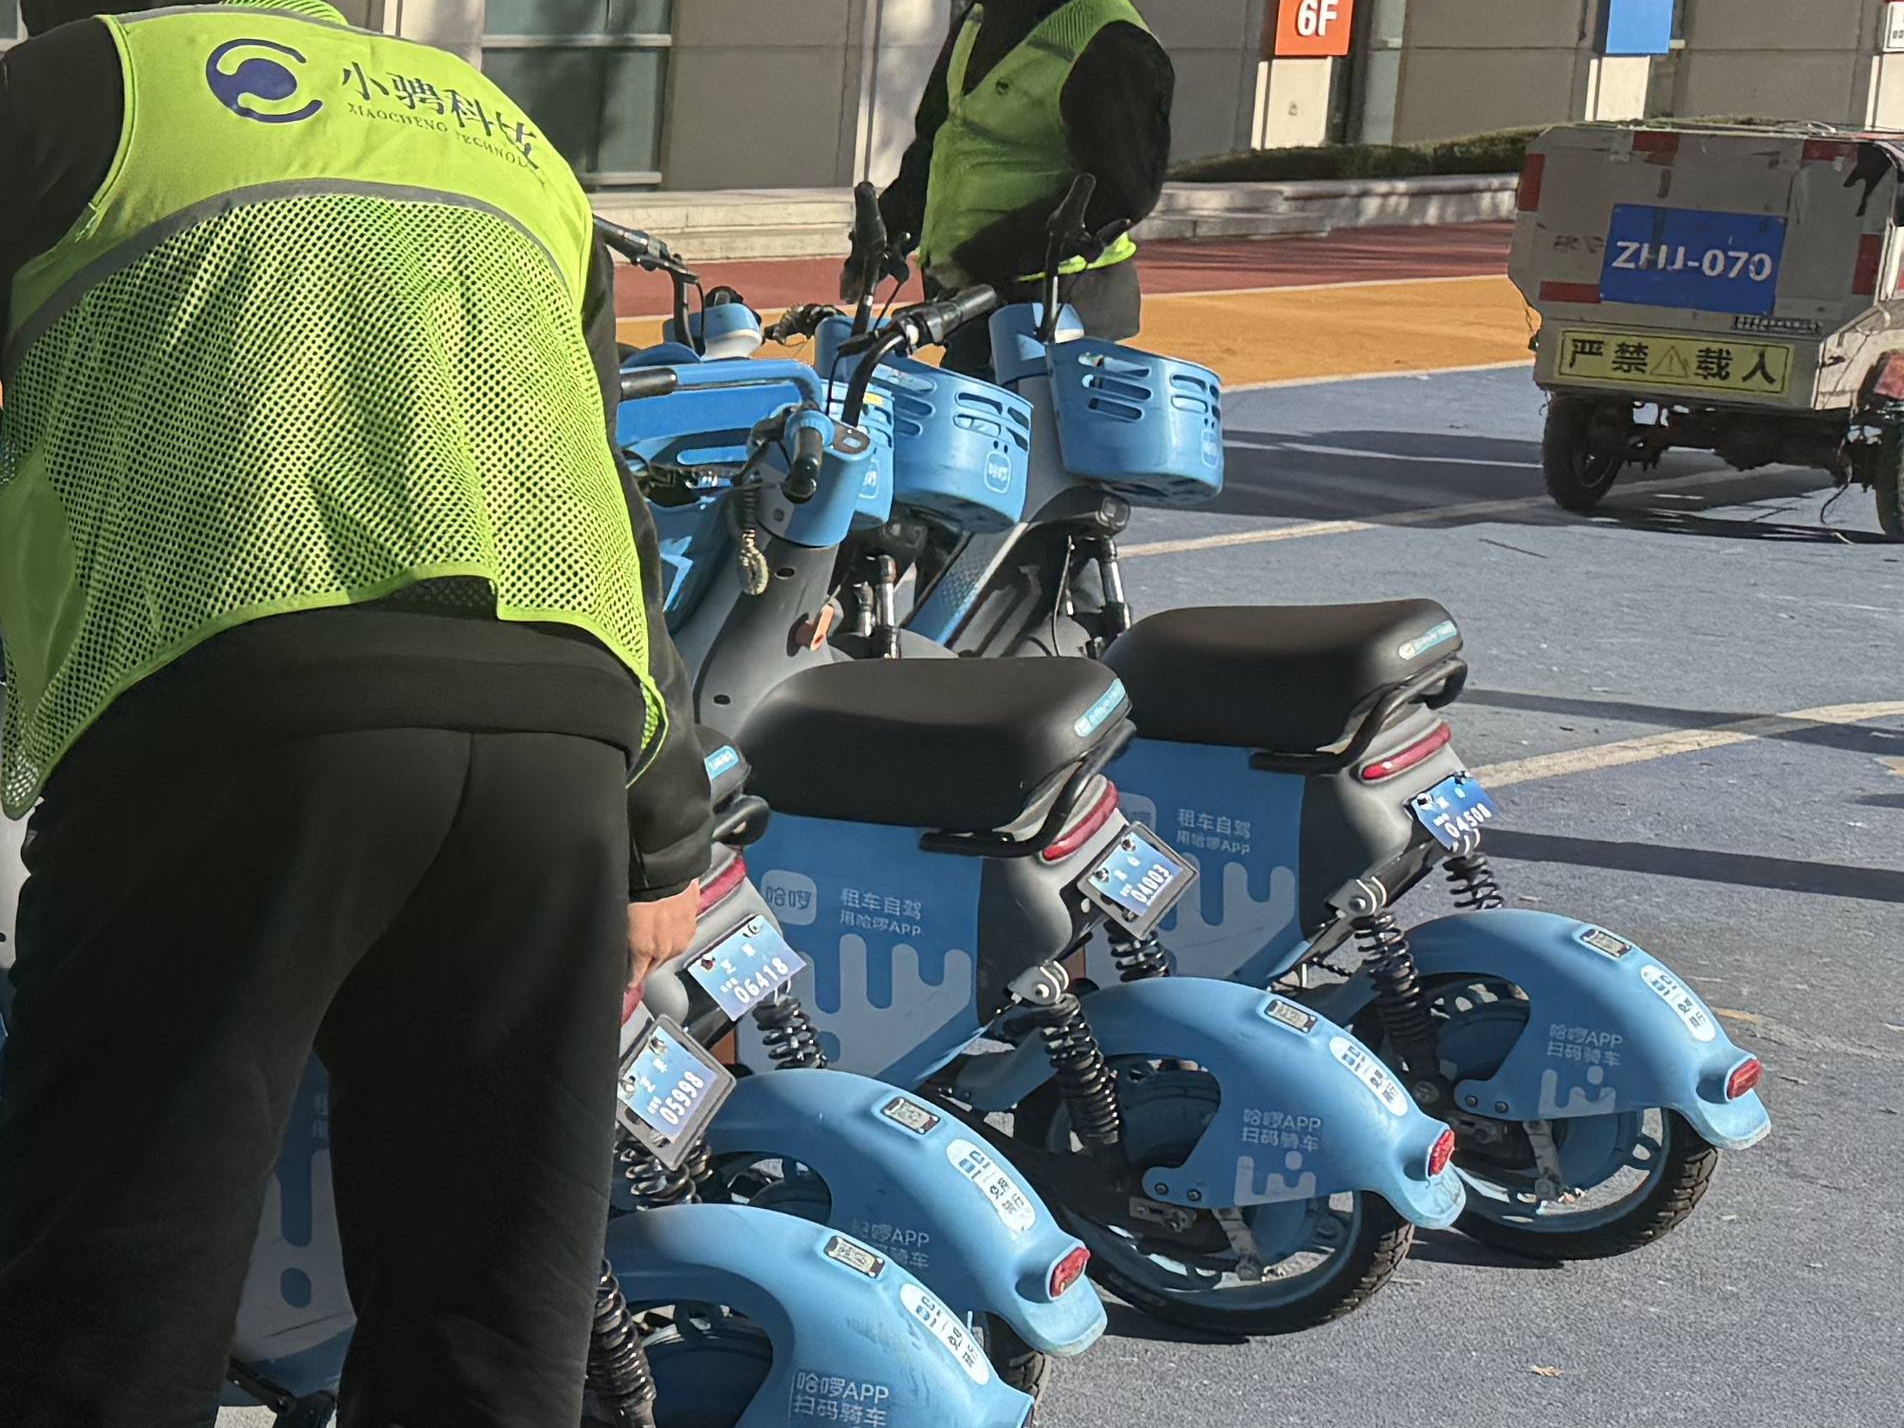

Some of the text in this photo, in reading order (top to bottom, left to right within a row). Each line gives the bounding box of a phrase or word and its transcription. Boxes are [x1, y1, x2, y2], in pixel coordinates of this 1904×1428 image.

[796, 1371, 890, 1404] 哈啰APP
[793, 1394, 887, 1428] 扫码骑车
